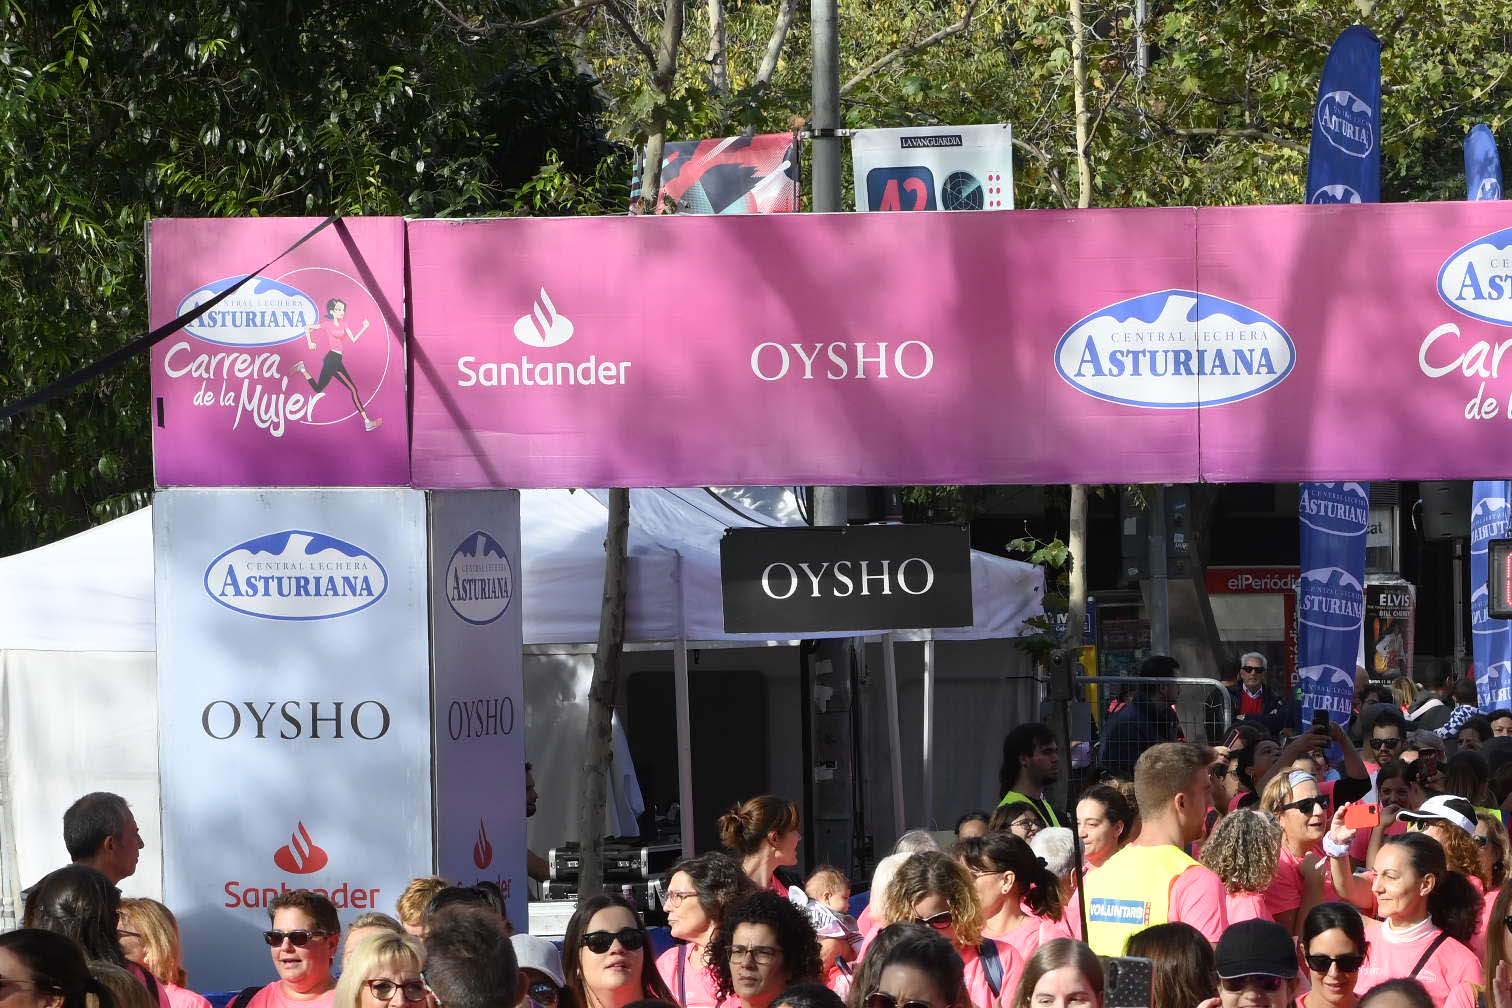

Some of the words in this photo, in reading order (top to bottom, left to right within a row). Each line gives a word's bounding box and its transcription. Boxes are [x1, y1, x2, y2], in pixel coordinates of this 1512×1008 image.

[187, 301, 307, 328] ASTURIANA
[1111, 330, 1186, 342] CENTRAL
[1194, 329, 1269, 341] LECHERA
[164, 341, 281, 379] Carrera
[457, 355, 631, 388] Santander
[750, 340, 934, 381] OYSHO
[1074, 334, 1278, 378] ASTURIANA
[193, 380, 215, 406] de
[219, 380, 235, 406] la
[233, 377, 326, 437] Mujer
[1464, 381, 1498, 420] de
[1300, 489, 1367, 525] ASTURIANA
[219, 563, 374, 598] ASTURIANA
[247, 561, 304, 571] CENTRAL
[309, 561, 368, 571] LECHERA
[451, 567, 509, 602] ASTURIANA
[761, 557, 935, 600] OYSHO
[1379, 594, 1410, 606] ELVIS
[202, 700, 391, 740] OYSHO
[448, 697, 514, 741] OYSHO
